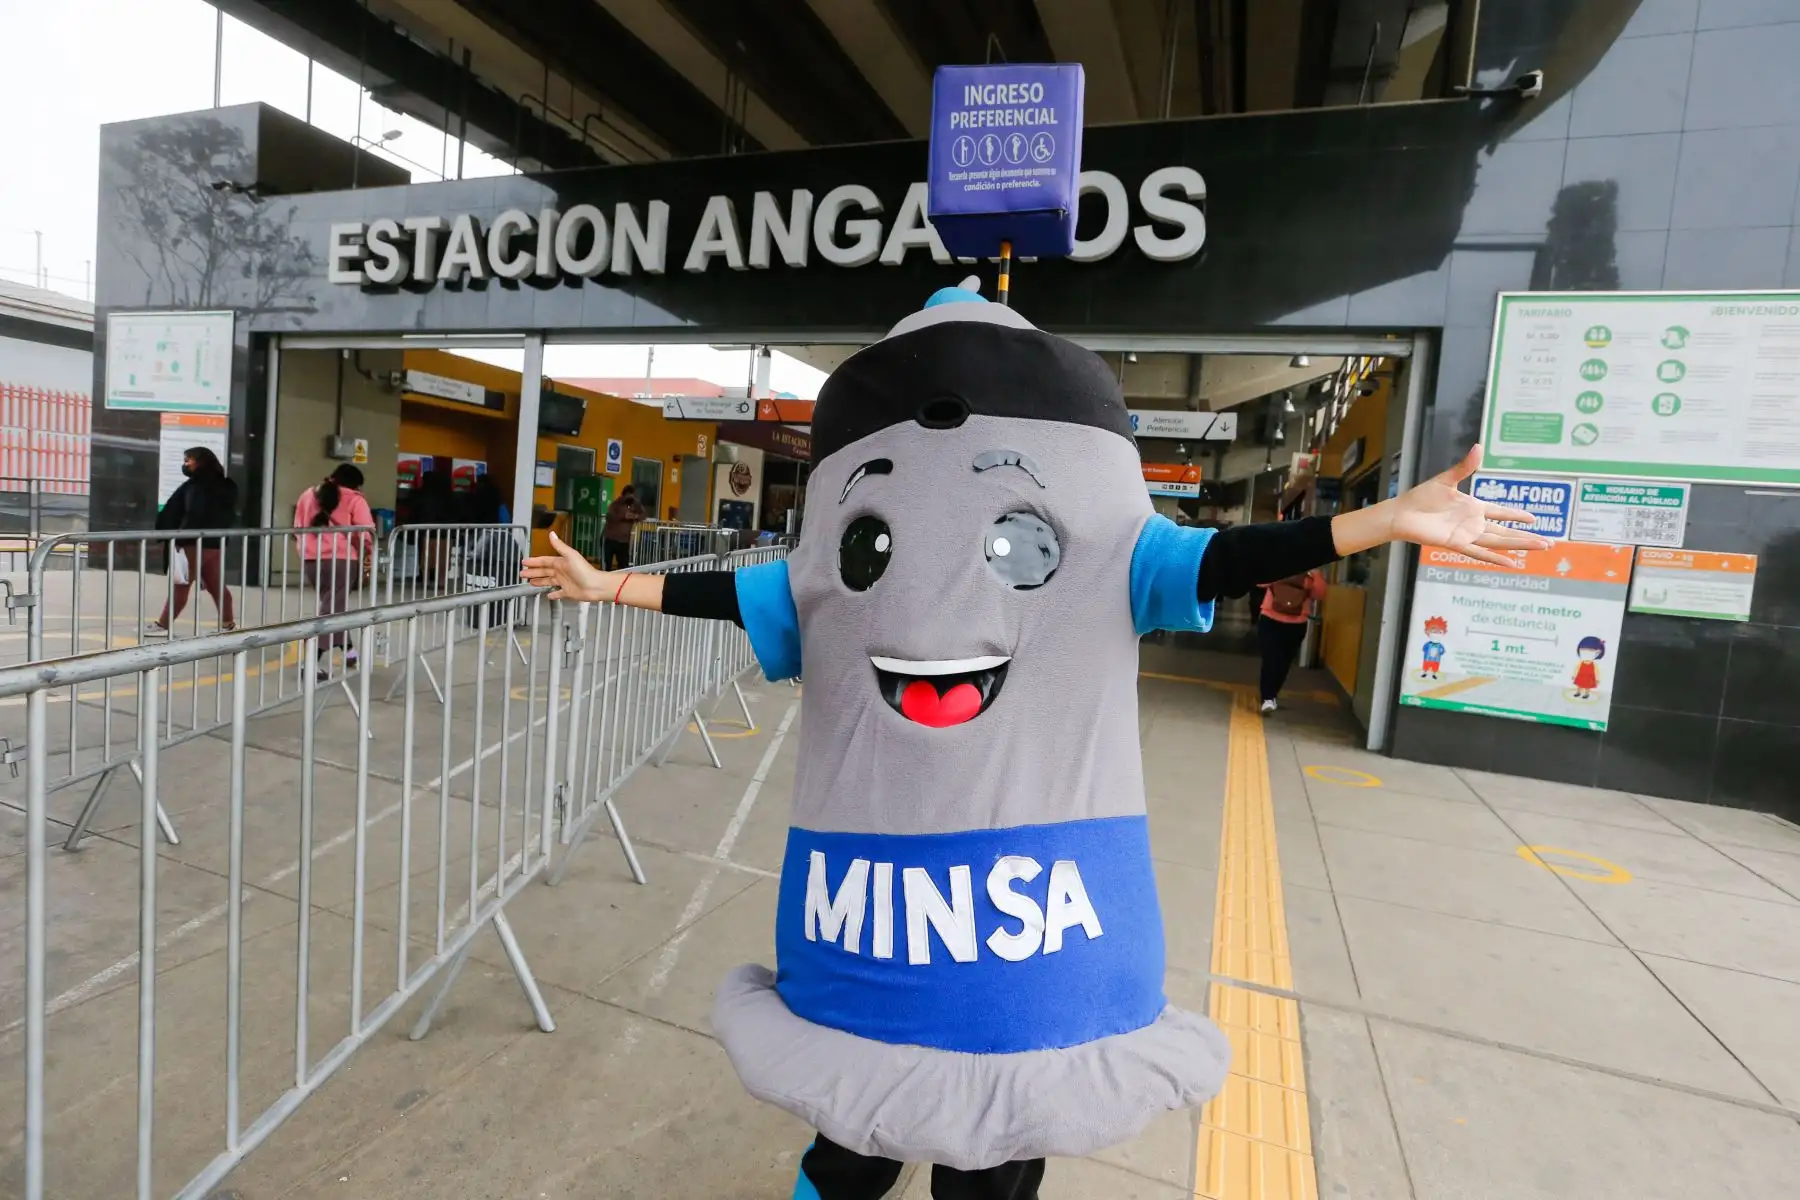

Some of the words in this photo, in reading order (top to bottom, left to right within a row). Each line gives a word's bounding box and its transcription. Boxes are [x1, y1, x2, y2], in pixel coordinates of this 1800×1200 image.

[964, 82, 1044, 106] INGRESO
[950, 107, 1058, 130] PREFERENCIAL
[964, 181, 995, 192] condición
[329, 199, 669, 285] ESTACION
[683, 166, 1207, 272] ANGAOS
[1507, 485, 1565, 505] AFORO
[1629, 495, 1641, 504] AL
[1646, 488, 1660, 497] DE
[1427, 567, 1451, 581] Por
[1453, 570, 1471, 582] tu
[1472, 574, 1550, 591] seguridad
[1452, 595, 1517, 612] Mantener
[1521, 603, 1535, 613] el
[1537, 605, 1582, 619] metro
[1471, 613, 1489, 624] de
[1492, 615, 1556, 632] distancia
[1491, 639, 1500, 651] 1
[804, 849, 1104, 966] MINSA
